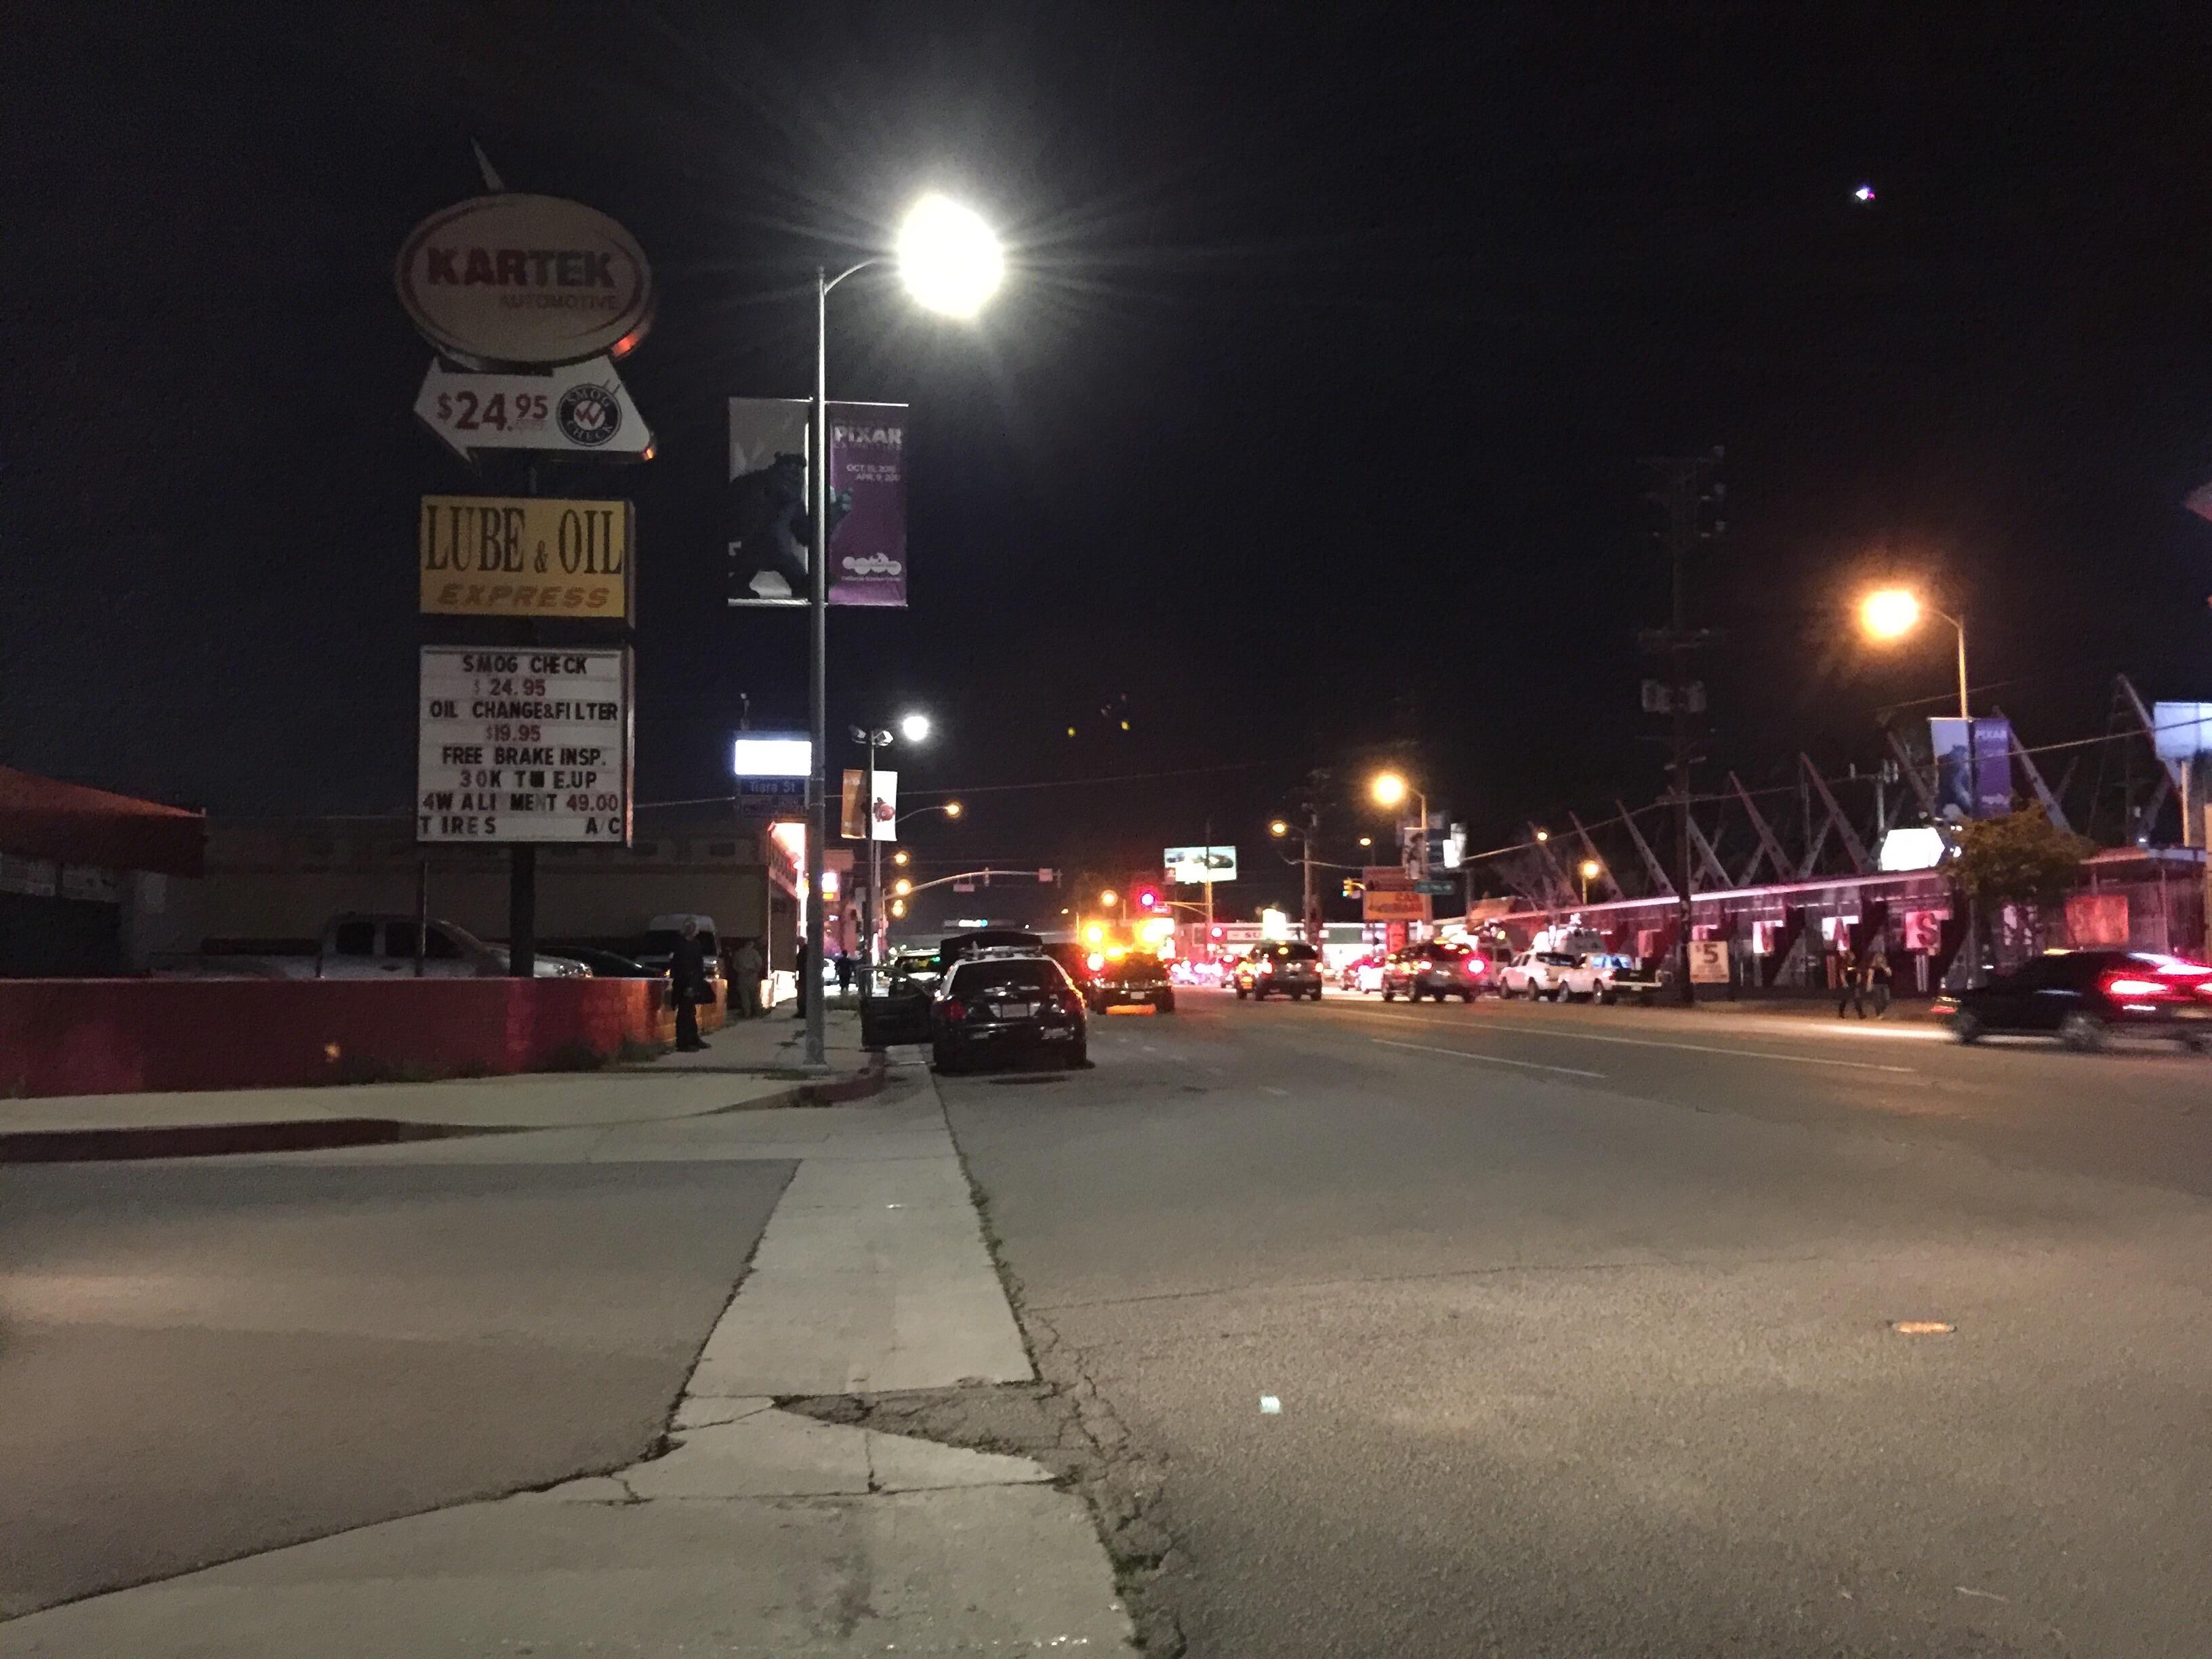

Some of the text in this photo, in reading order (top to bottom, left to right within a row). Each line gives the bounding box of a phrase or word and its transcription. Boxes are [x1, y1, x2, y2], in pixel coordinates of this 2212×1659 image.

[428, 247, 615, 288] KARTEK
[834, 426, 901, 445] PIXAR
[426, 505, 622, 575] LUBE & OIL
[439, 583, 609, 609] EXPRESS
[463, 655, 587, 674] SMOG CHECK
[430, 701, 459, 718] OIL
[442, 747, 483, 765] FREE
[495, 746, 554, 766] BRAKE
[459, 770, 501, 788] 30K
[567, 794, 619, 811] 49.00
